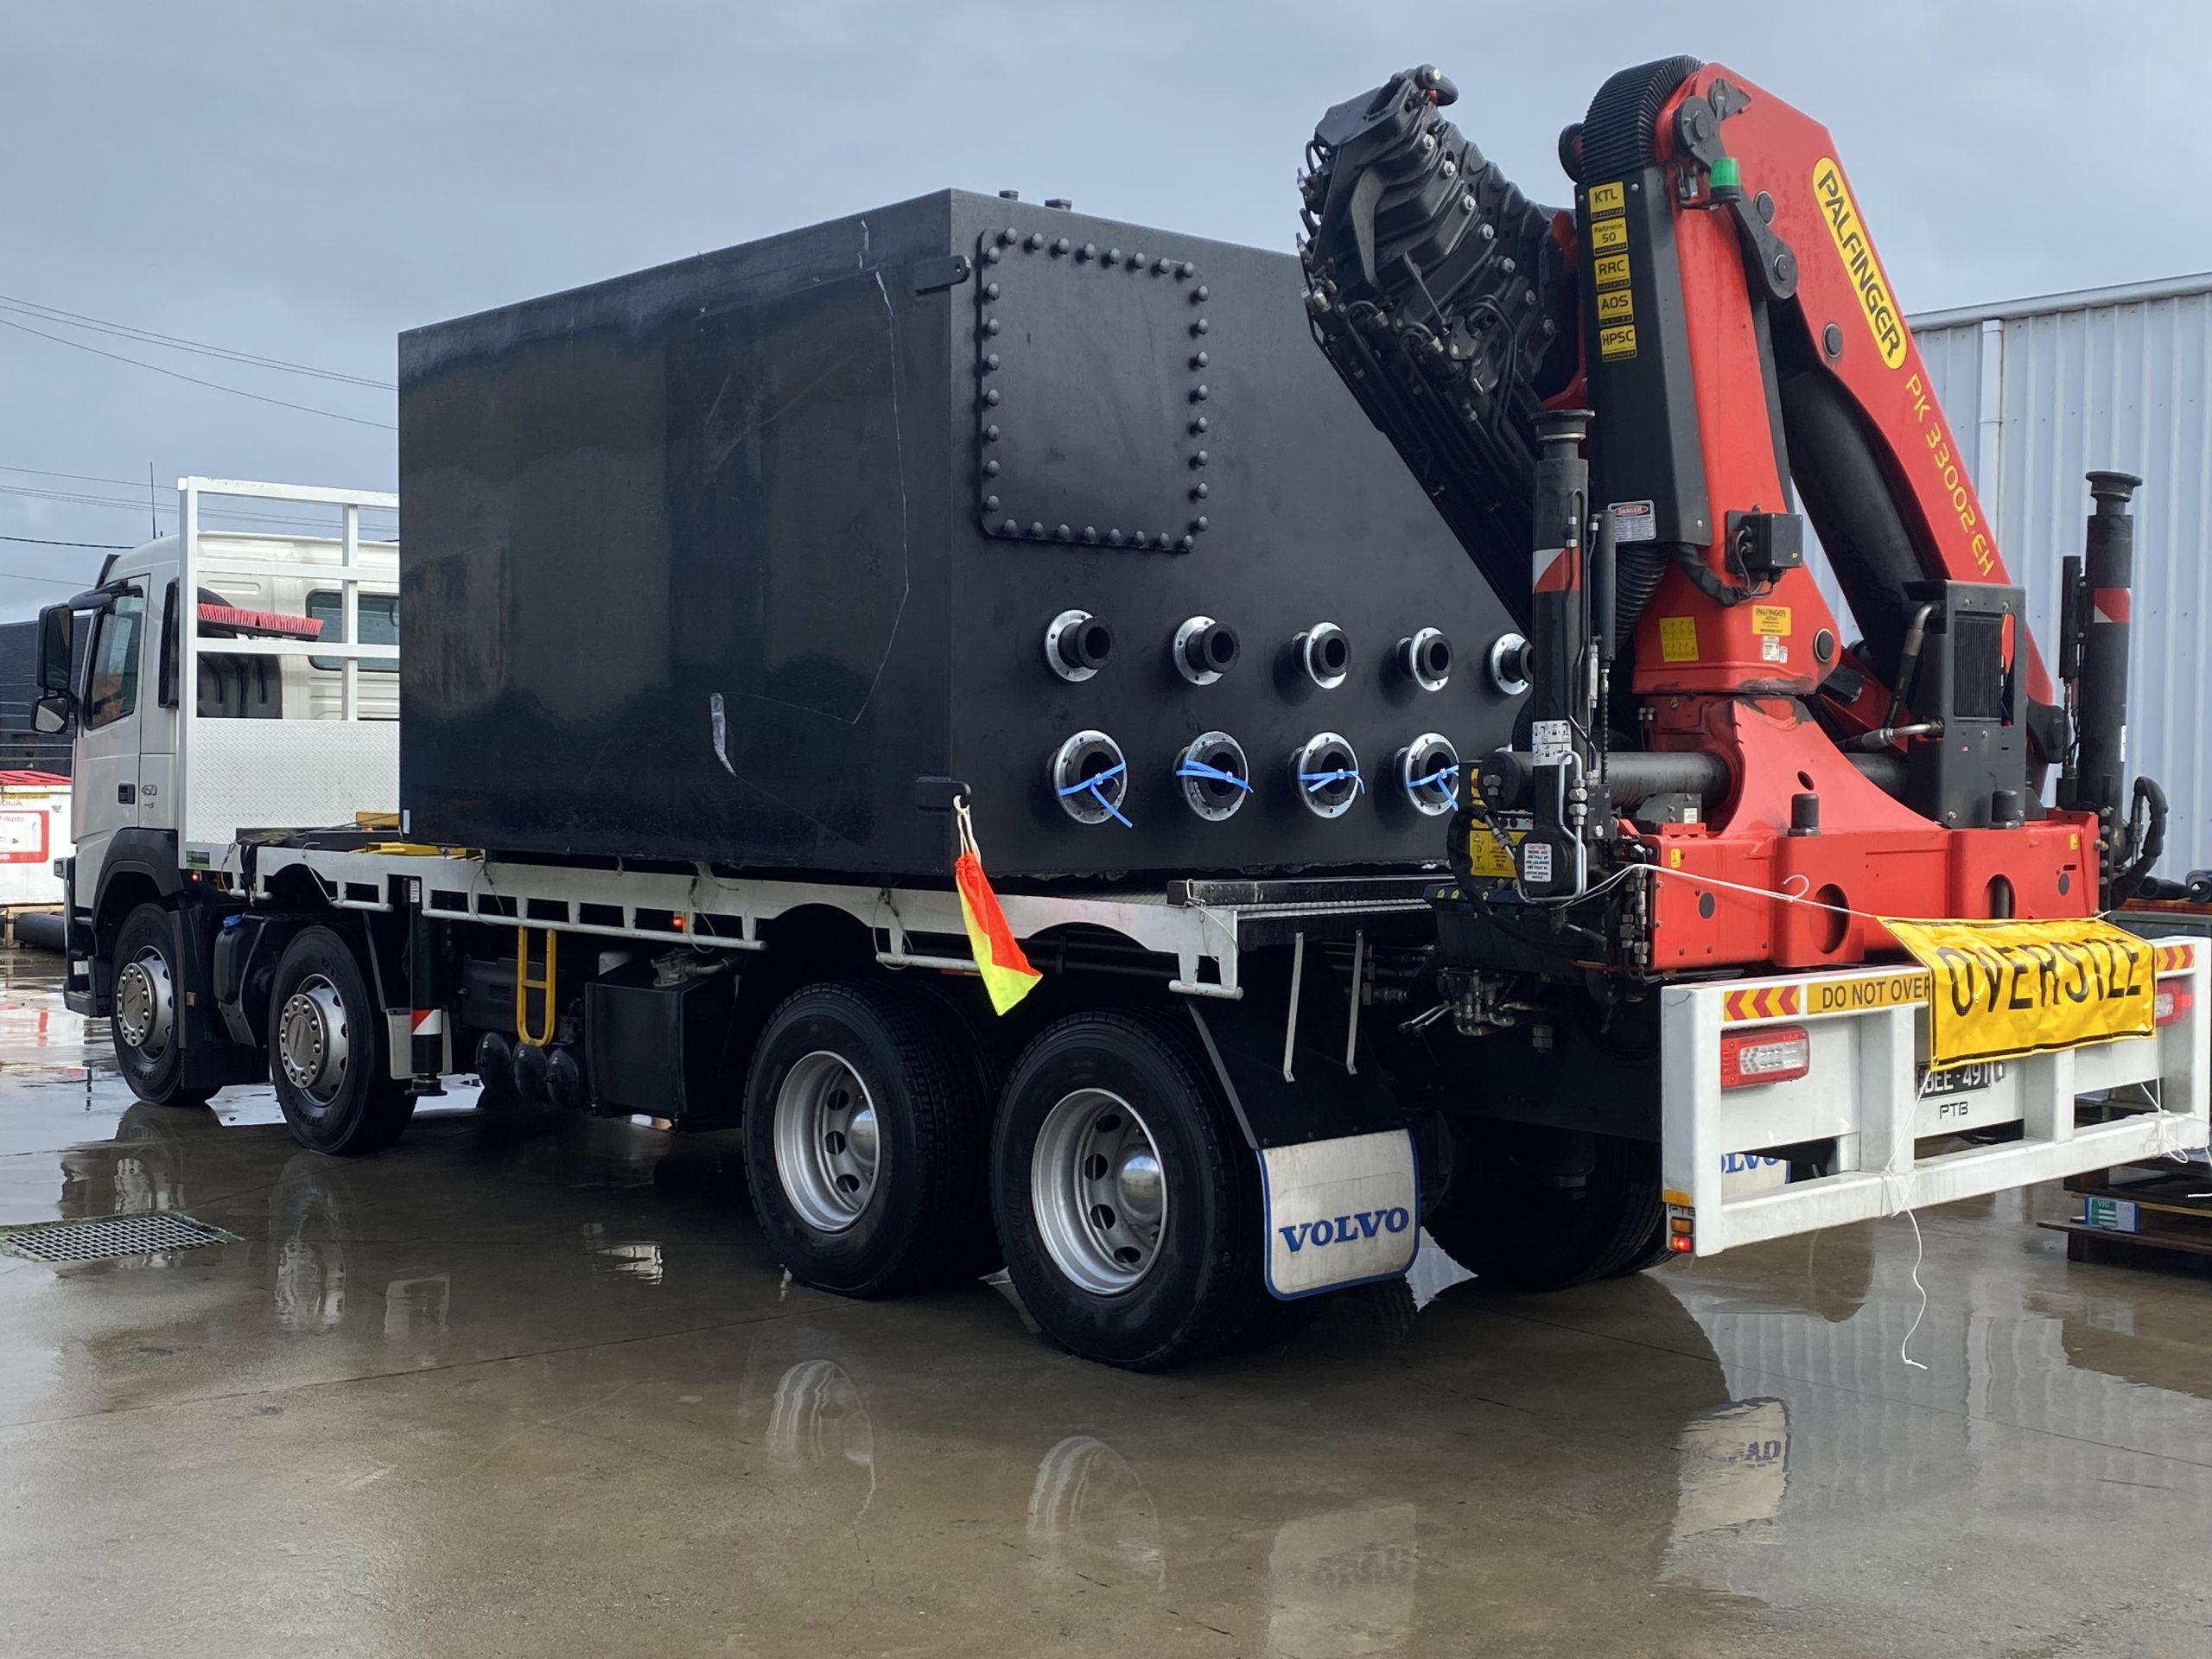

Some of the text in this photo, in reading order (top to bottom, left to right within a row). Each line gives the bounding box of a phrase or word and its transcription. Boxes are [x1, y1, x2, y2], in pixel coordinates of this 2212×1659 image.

[1595, 188, 1618, 203] KTL
[1602, 232, 1616, 243] 50
[1599, 260, 1625, 275] RRC
[1818, 169, 1901, 359] PALFINGER
[1601, 295, 1629, 311] AOS
[1603, 330, 1633, 346] HPSC
[1905, 373, 1931, 422] PK
[1936, 938, 2141, 1017] OVERSIZE
[1822, 985, 1847, 1009] DO
[1852, 981, 1886, 1006] NOT
[1939, 1101, 1968, 1119] PTB
[1279, 1207, 1409, 1253] VOLVO
